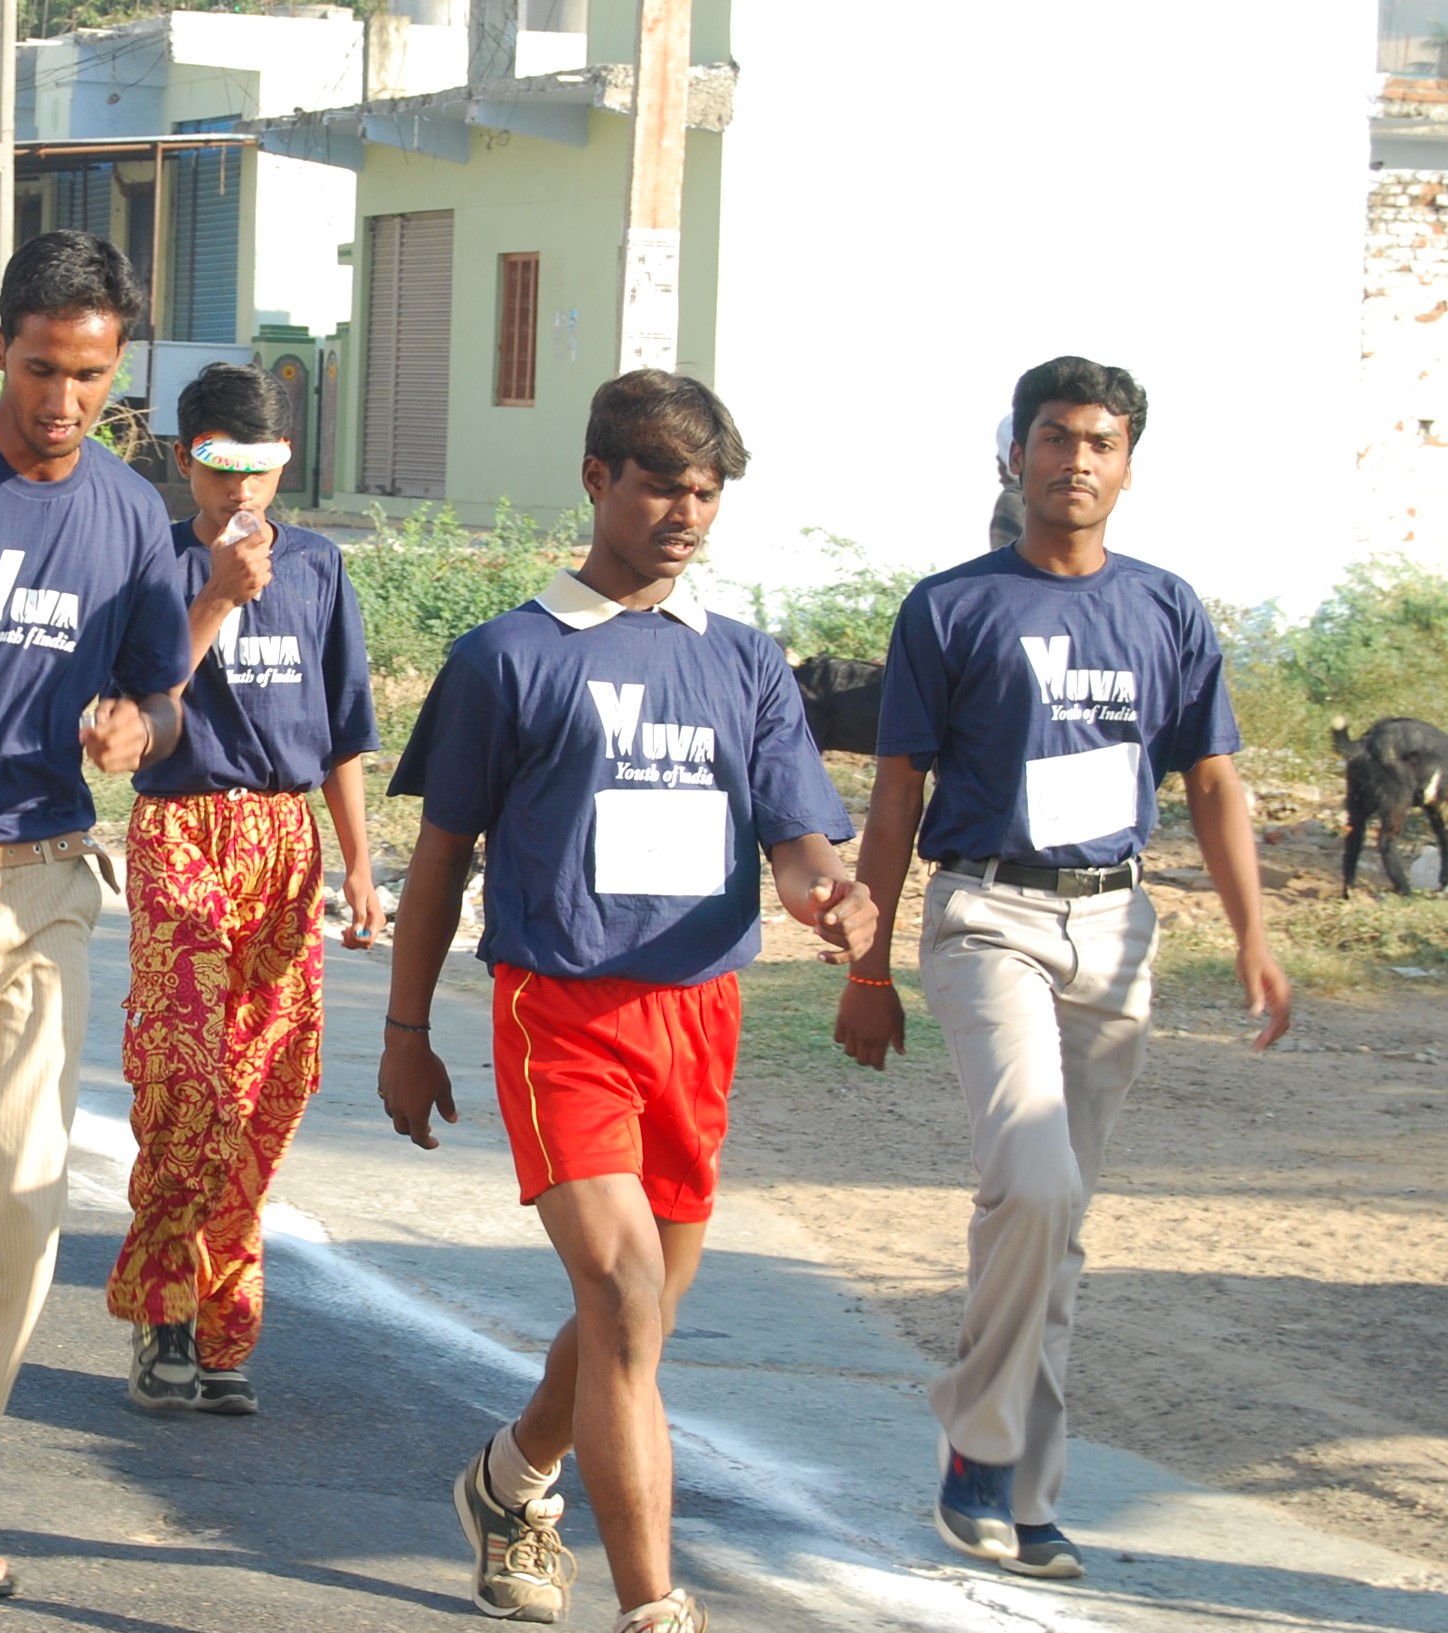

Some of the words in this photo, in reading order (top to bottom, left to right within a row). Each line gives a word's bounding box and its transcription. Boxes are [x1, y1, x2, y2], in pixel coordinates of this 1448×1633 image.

[32, 627, 77, 653] India
[256, 667, 273, 689] of
[1082, 704, 1101, 725] of
[1098, 705, 1137, 722] India
[615, 761, 660, 782] Youth
[662, 764, 680, 789] of
[679, 766, 714, 786] India
